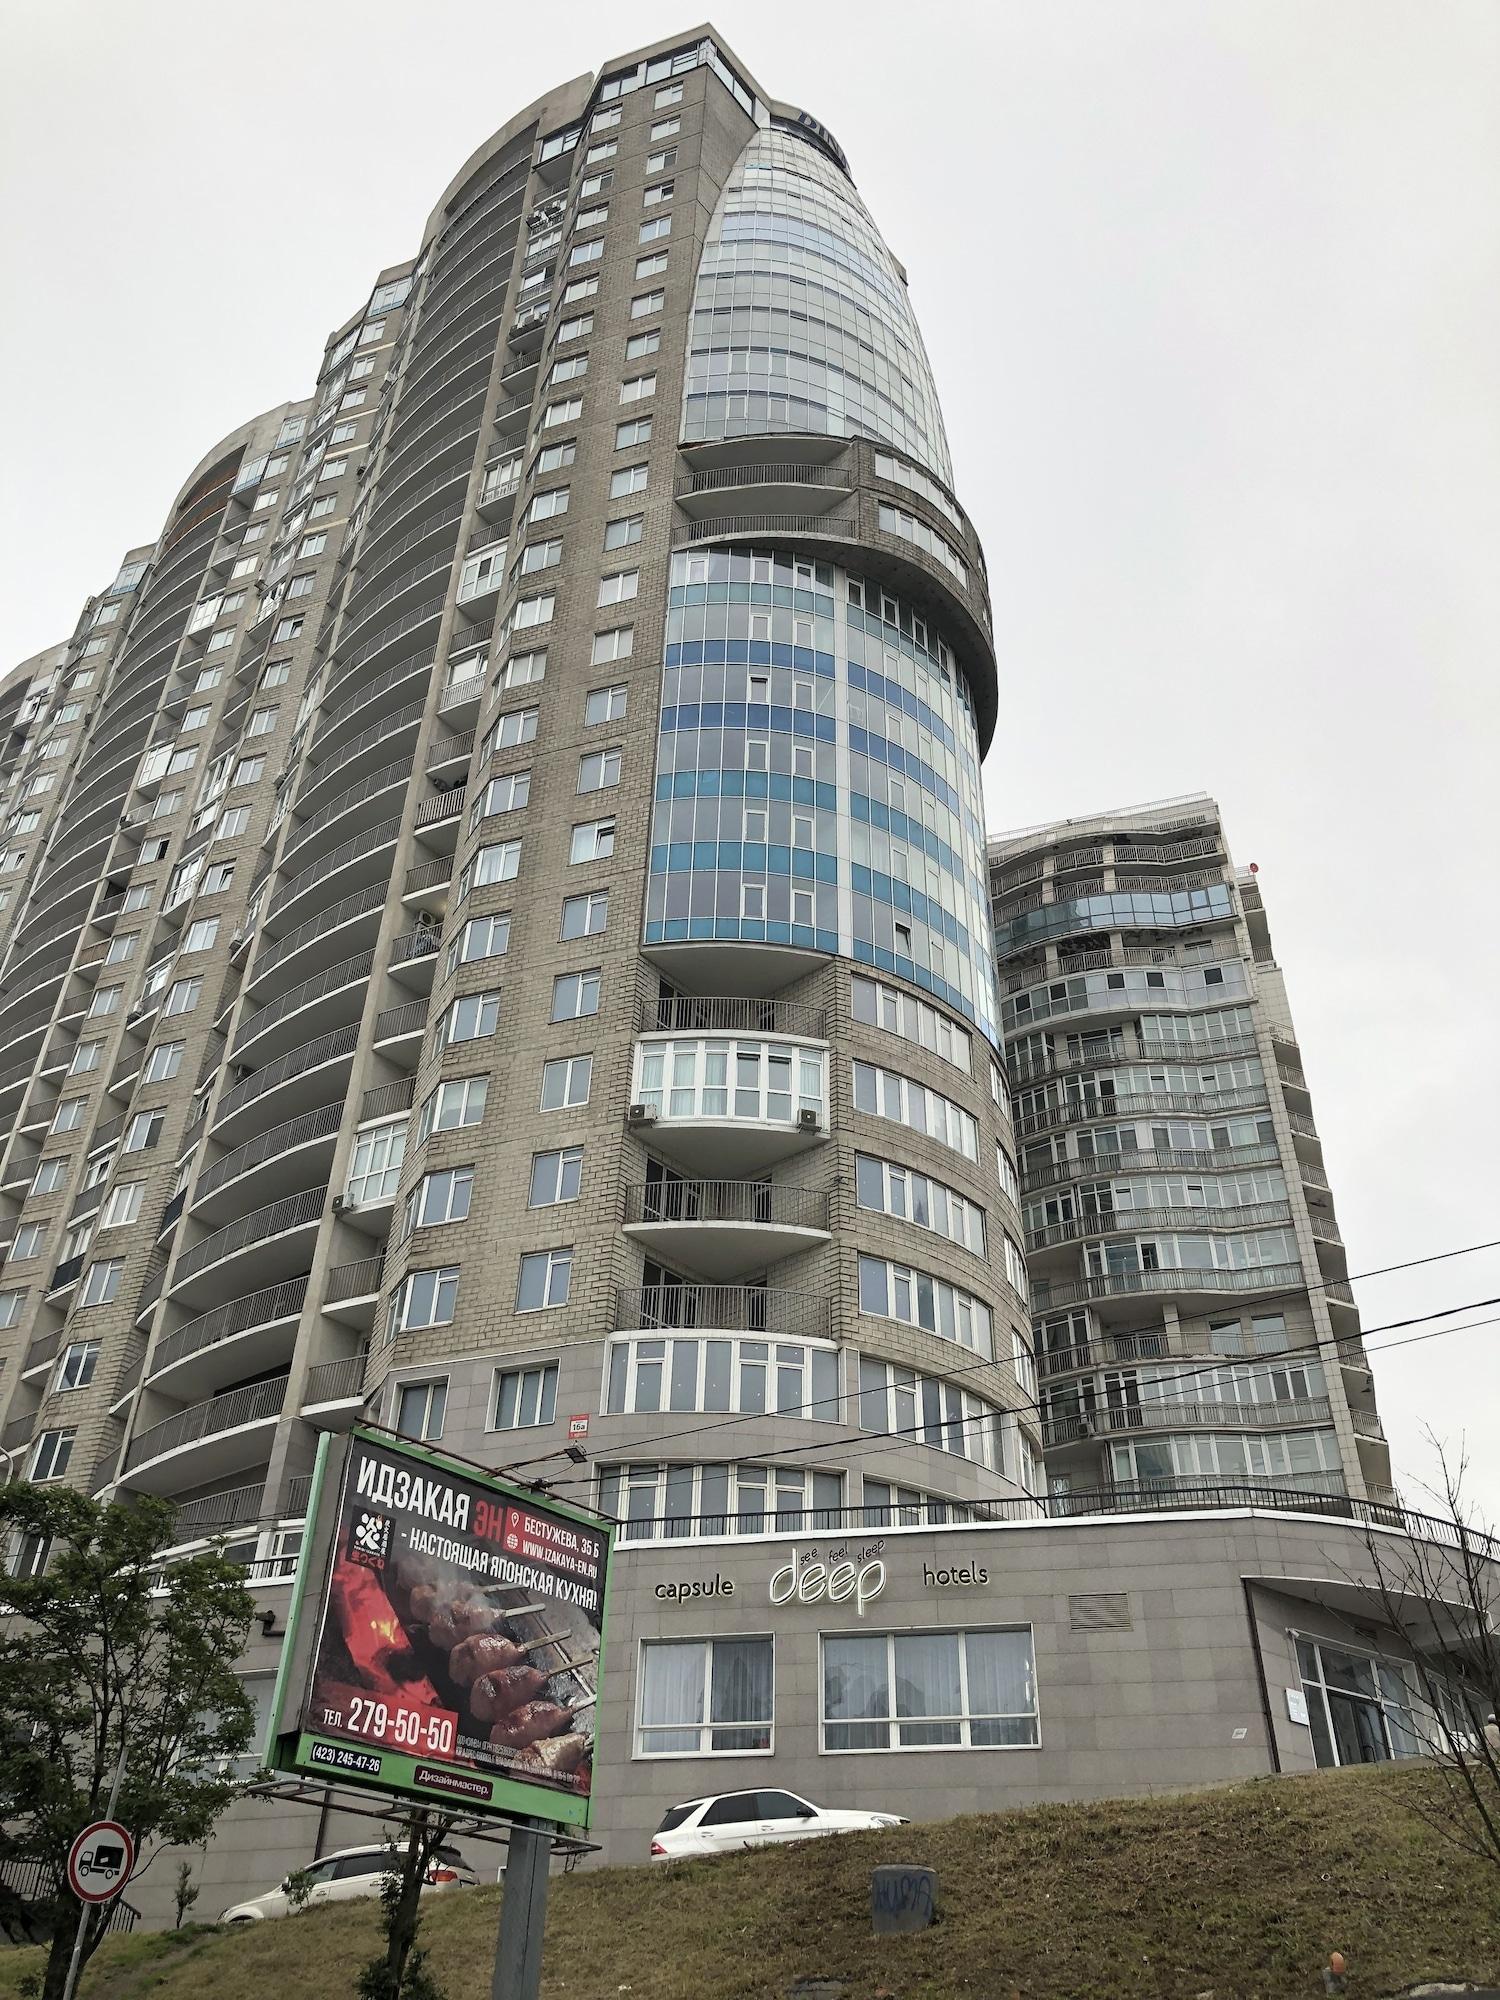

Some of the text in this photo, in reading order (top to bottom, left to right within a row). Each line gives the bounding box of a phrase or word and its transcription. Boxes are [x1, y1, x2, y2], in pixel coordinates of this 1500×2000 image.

[356, 1456, 504, 1542] ИДЗАКАЯ ЭН
[524, 1516, 600, 1558] БЕСТУЖЕВА, 35 Б
[800, 1539, 885, 1565] see feel sleep
[409, 1527, 489, 1574] НАСТОЯЩАЯ
[490, 1556, 553, 1596] ЯПОНСКАЯ
[555, 1577, 597, 1611] КУХНЯ!
[522, 1539, 598, 1579] WWW.IZAKAYA-EN.RU
[923, 1561, 988, 1586] hotels
[655, 1573, 734, 1603] capsule
[769, 1548, 886, 1618] deep
[323, 1708, 343, 1728] ТЕЛ.
[347, 1697, 453, 1753] 279-50-50
[312, 1745, 381, 1772] (423) 245-47-26
[418, 1770, 490, 1795] Дизайнмастер.
